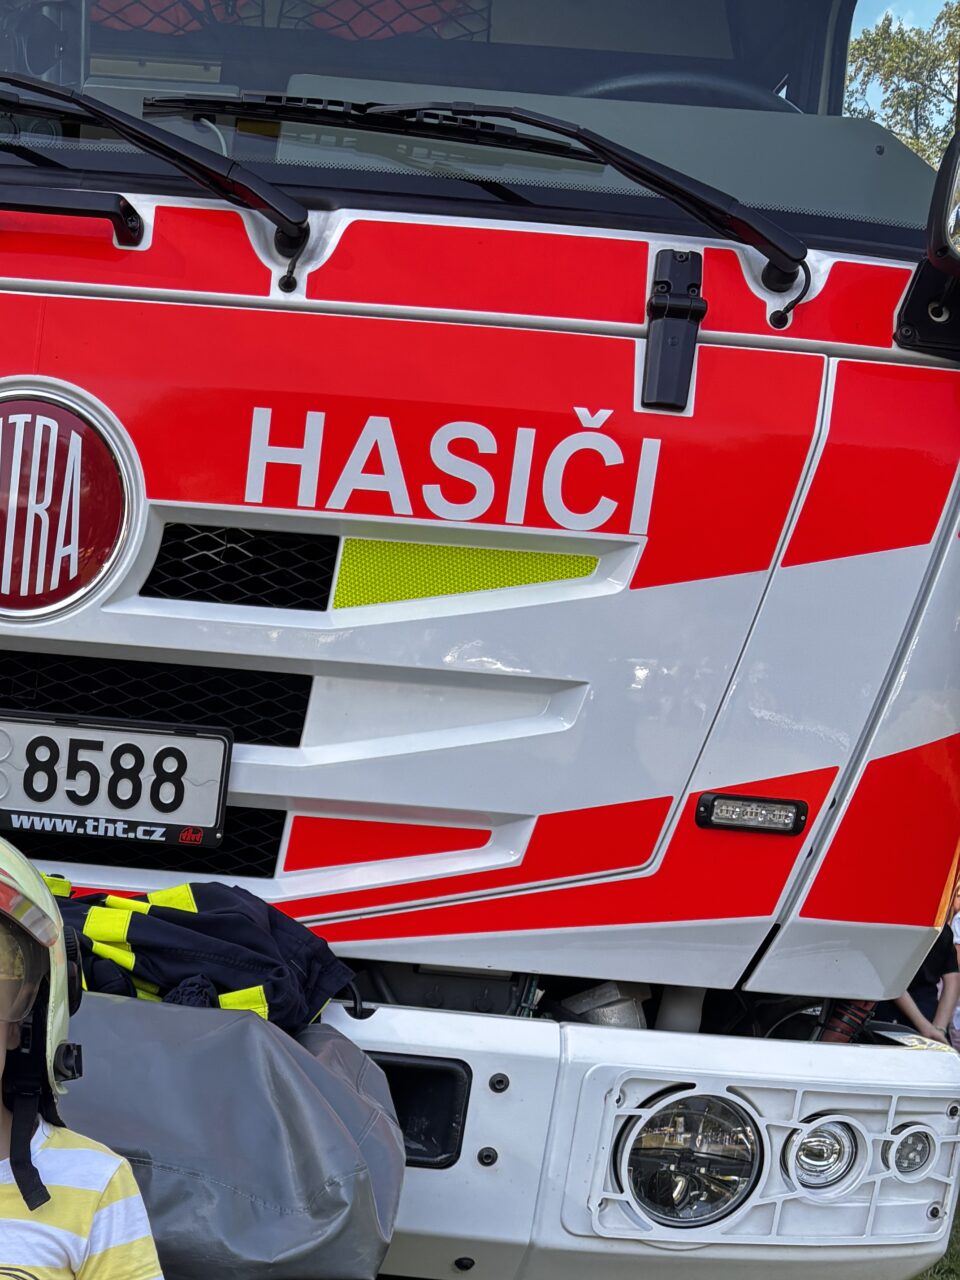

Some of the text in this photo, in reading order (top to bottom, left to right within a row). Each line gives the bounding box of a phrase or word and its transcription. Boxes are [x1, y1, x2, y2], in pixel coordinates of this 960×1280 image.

[244, 406, 661, 535] HASIČI
[23, 736, 188, 813] 8588
[11, 814, 167, 841] www.tht.cz
